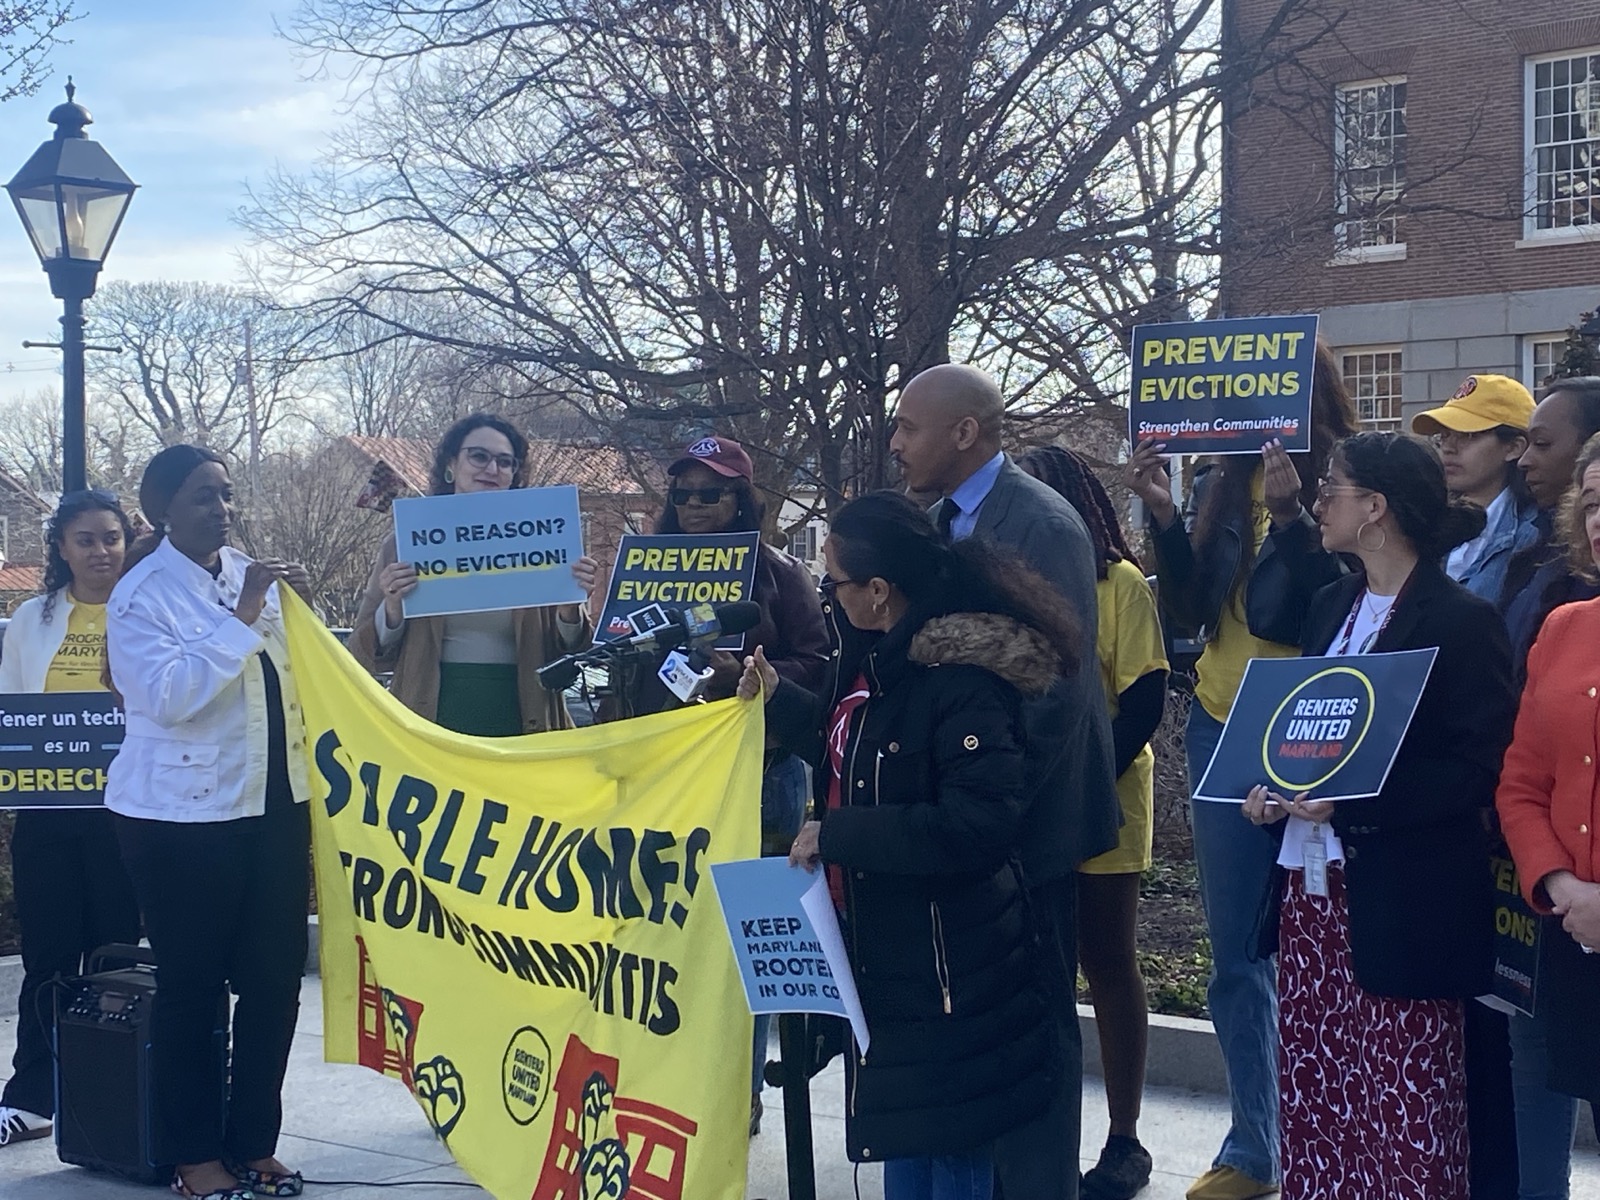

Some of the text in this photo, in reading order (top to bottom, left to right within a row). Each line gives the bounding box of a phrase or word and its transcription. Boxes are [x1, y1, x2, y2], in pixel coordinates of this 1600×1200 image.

[1143, 332, 1305, 367] PREVENT
[1140, 371, 1300, 402] EVICTIONS
[1138, 415, 1299, 437] Strengthen Communities
[412, 517, 566, 547] NO REASON?
[414, 548, 567, 577] NO EVICTION!
[625, 546, 750, 572] PREVENT
[617, 580, 743, 603] EVICTIONS
[64, 633, 106, 644] ROGR
[1293, 698, 1359, 717] RENTERS
[53, 714, 76, 726] un
[1285, 718, 1351, 741] UNITED
[44, 741, 90, 753] es un
[1278, 744, 1343, 759] MARYLAND
[741, 917, 802, 938] KEEP
[759, 983, 843, 1002] IN OUR CO
